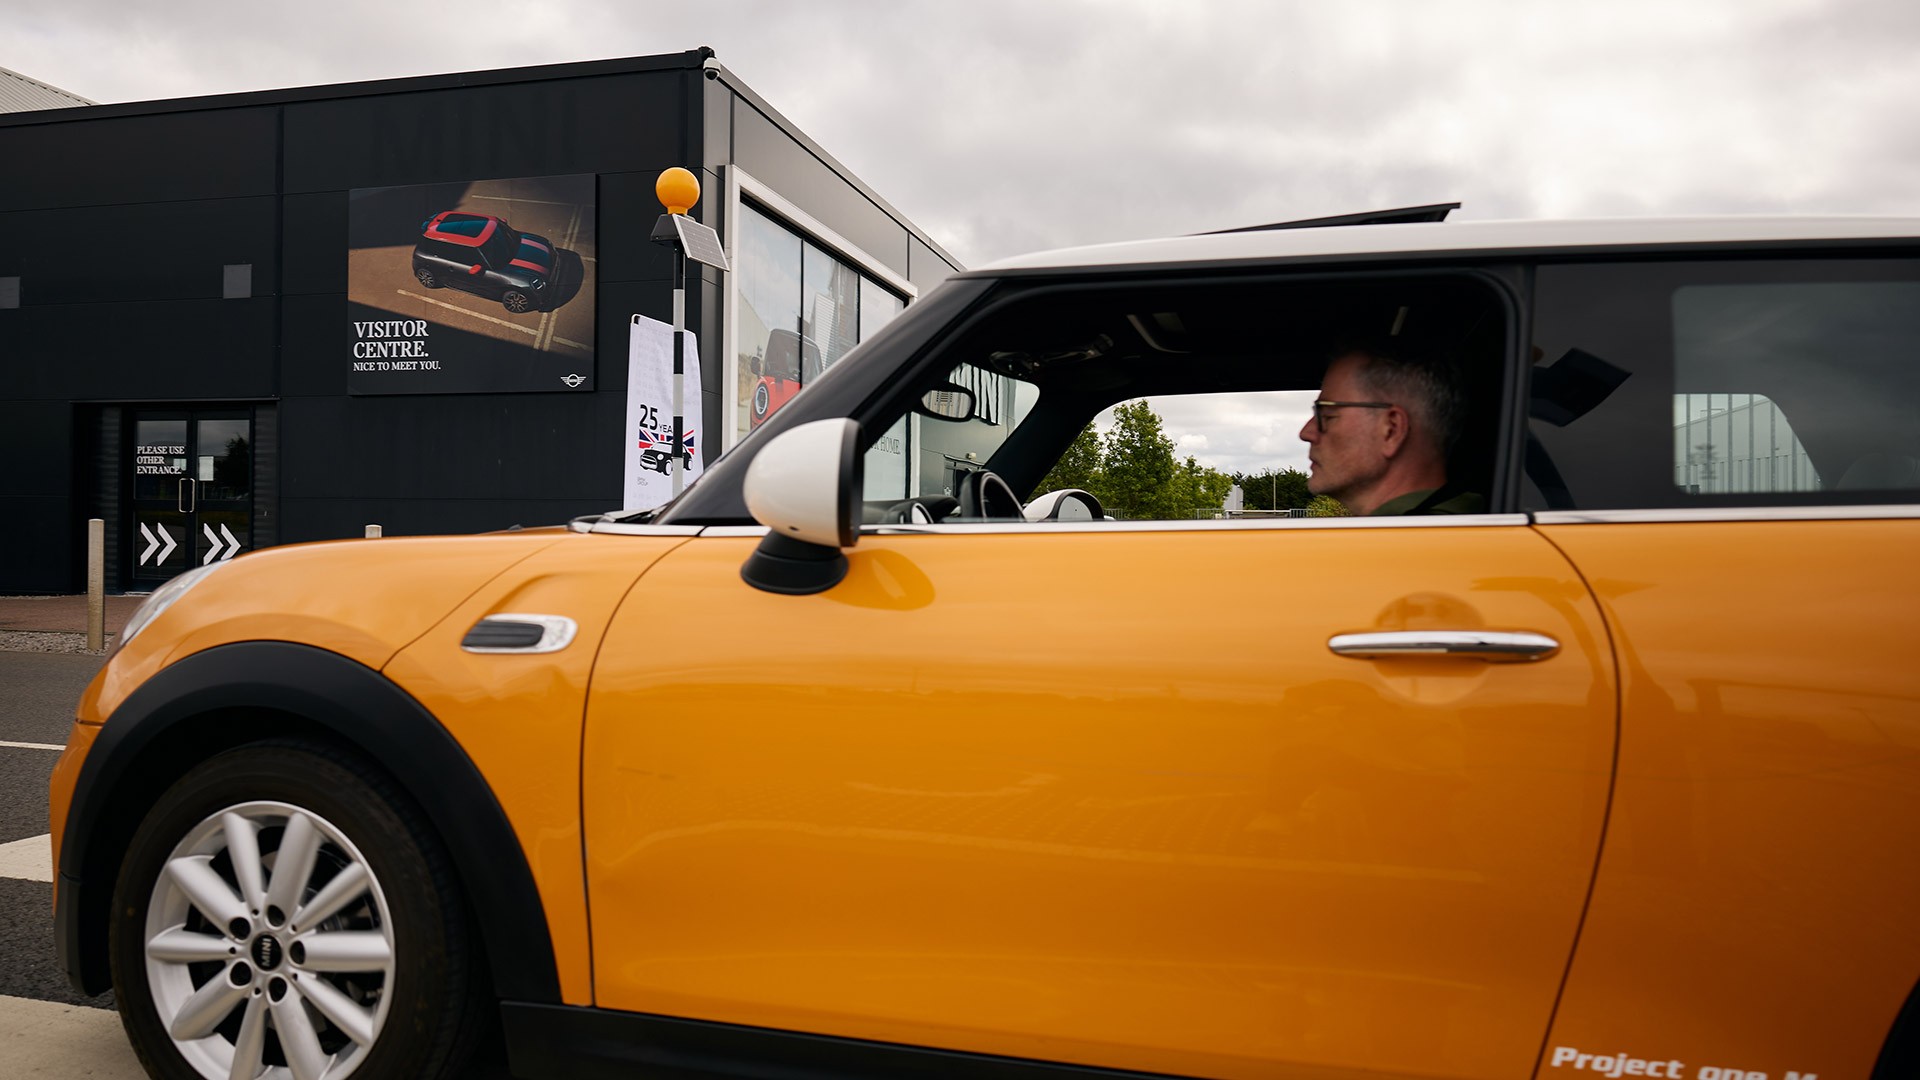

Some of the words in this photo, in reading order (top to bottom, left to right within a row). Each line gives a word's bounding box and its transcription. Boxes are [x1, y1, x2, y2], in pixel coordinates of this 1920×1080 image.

[353, 320, 429, 338] VISITOR
[353, 340, 429, 359] CENTRE.
[353, 362, 375, 371] NICE
[377, 361, 390, 371] TO
[391, 361, 418, 371] MEET
[419, 360, 441, 370] YOU.
[639, 404, 658, 431] 25
[137, 446, 168, 455] PLEASE
[169, 446, 185, 455] USE
[136, 456, 165, 465] OTHER
[261, 938, 273, 967] MINI
[1551, 1046, 1685, 1079] Project
[1697, 1066, 1768, 1080] one
